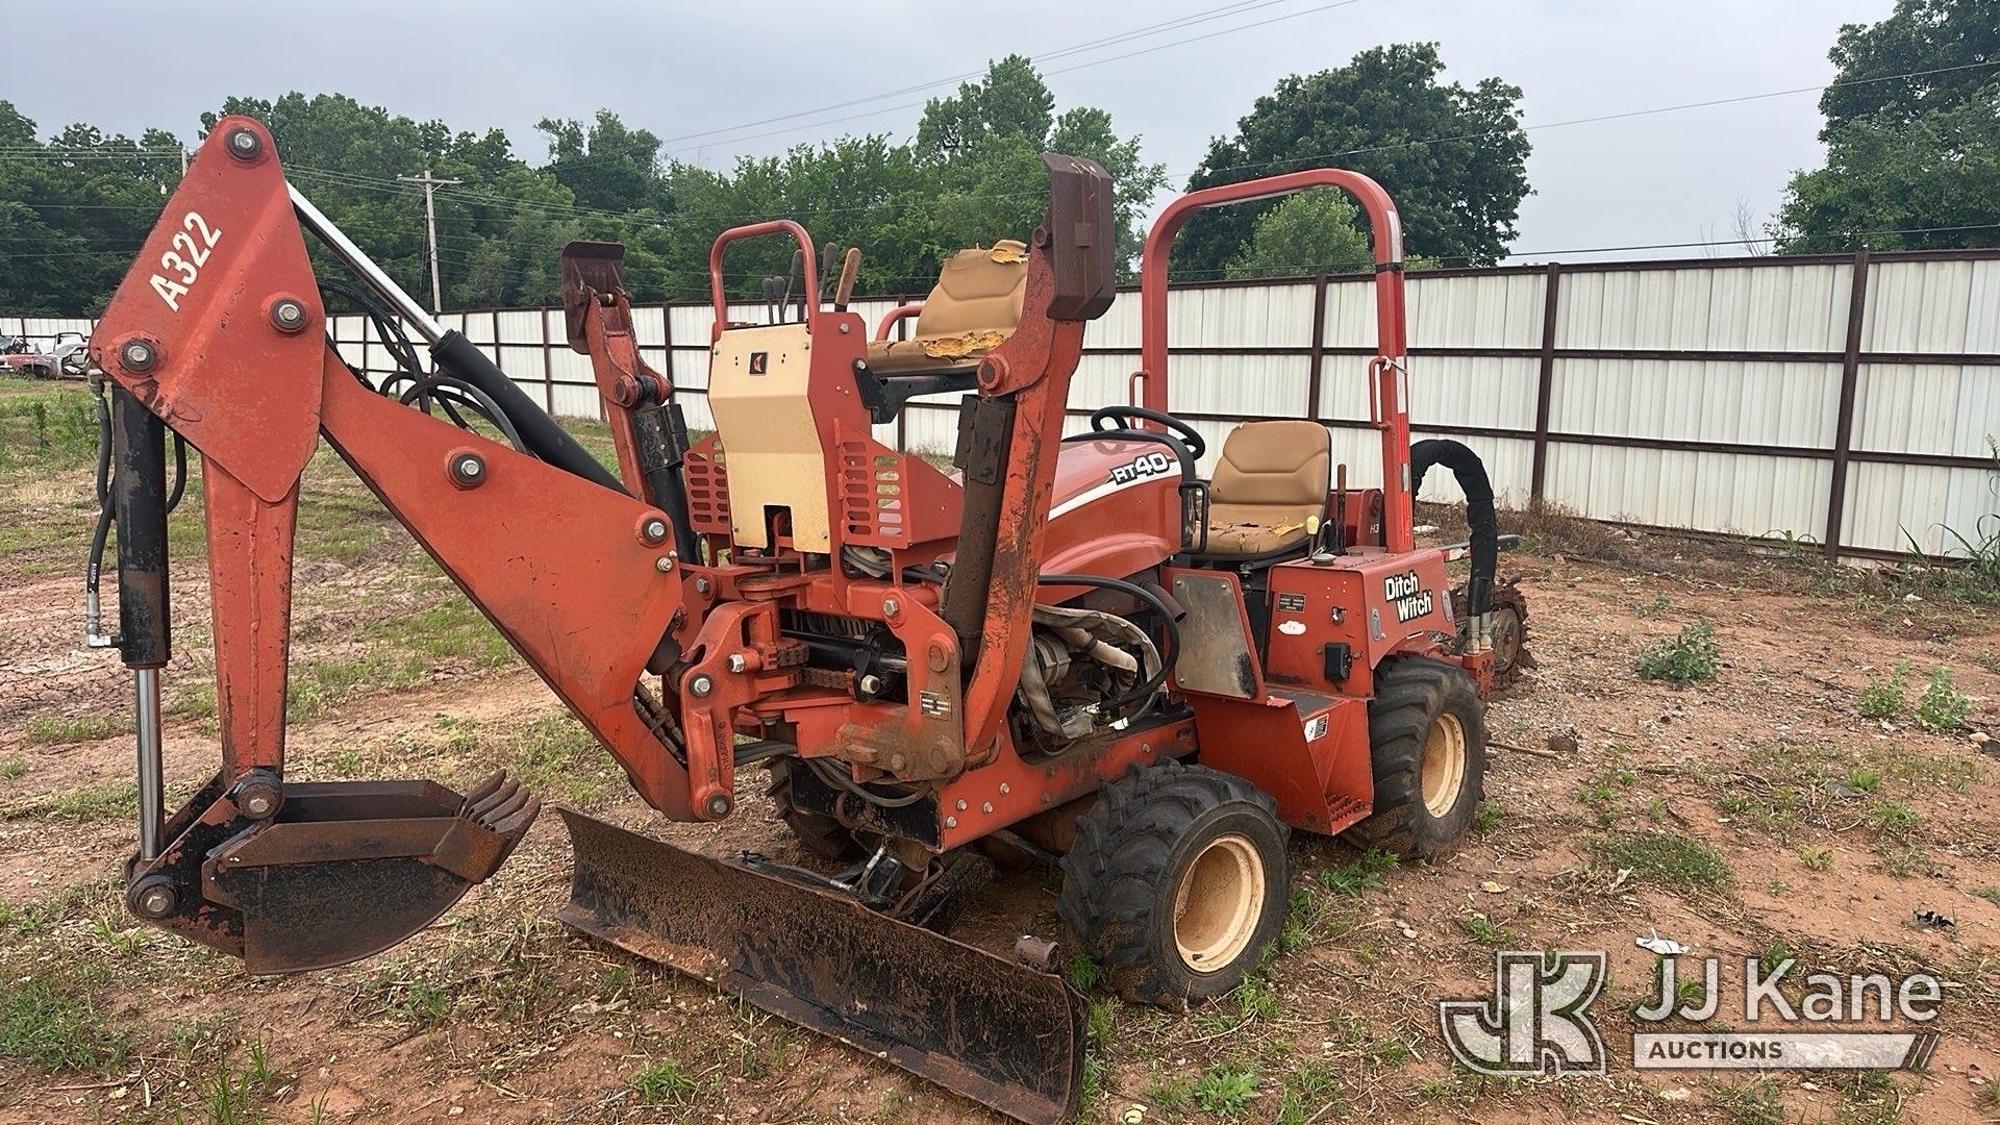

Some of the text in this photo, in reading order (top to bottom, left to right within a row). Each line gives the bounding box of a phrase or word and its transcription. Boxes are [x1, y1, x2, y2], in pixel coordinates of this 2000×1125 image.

[149, 211, 222, 312] A322
[1111, 452, 1168, 483] RT40
[1385, 572, 1419, 600] Ditch
[1397, 592, 1432, 621] Witch
